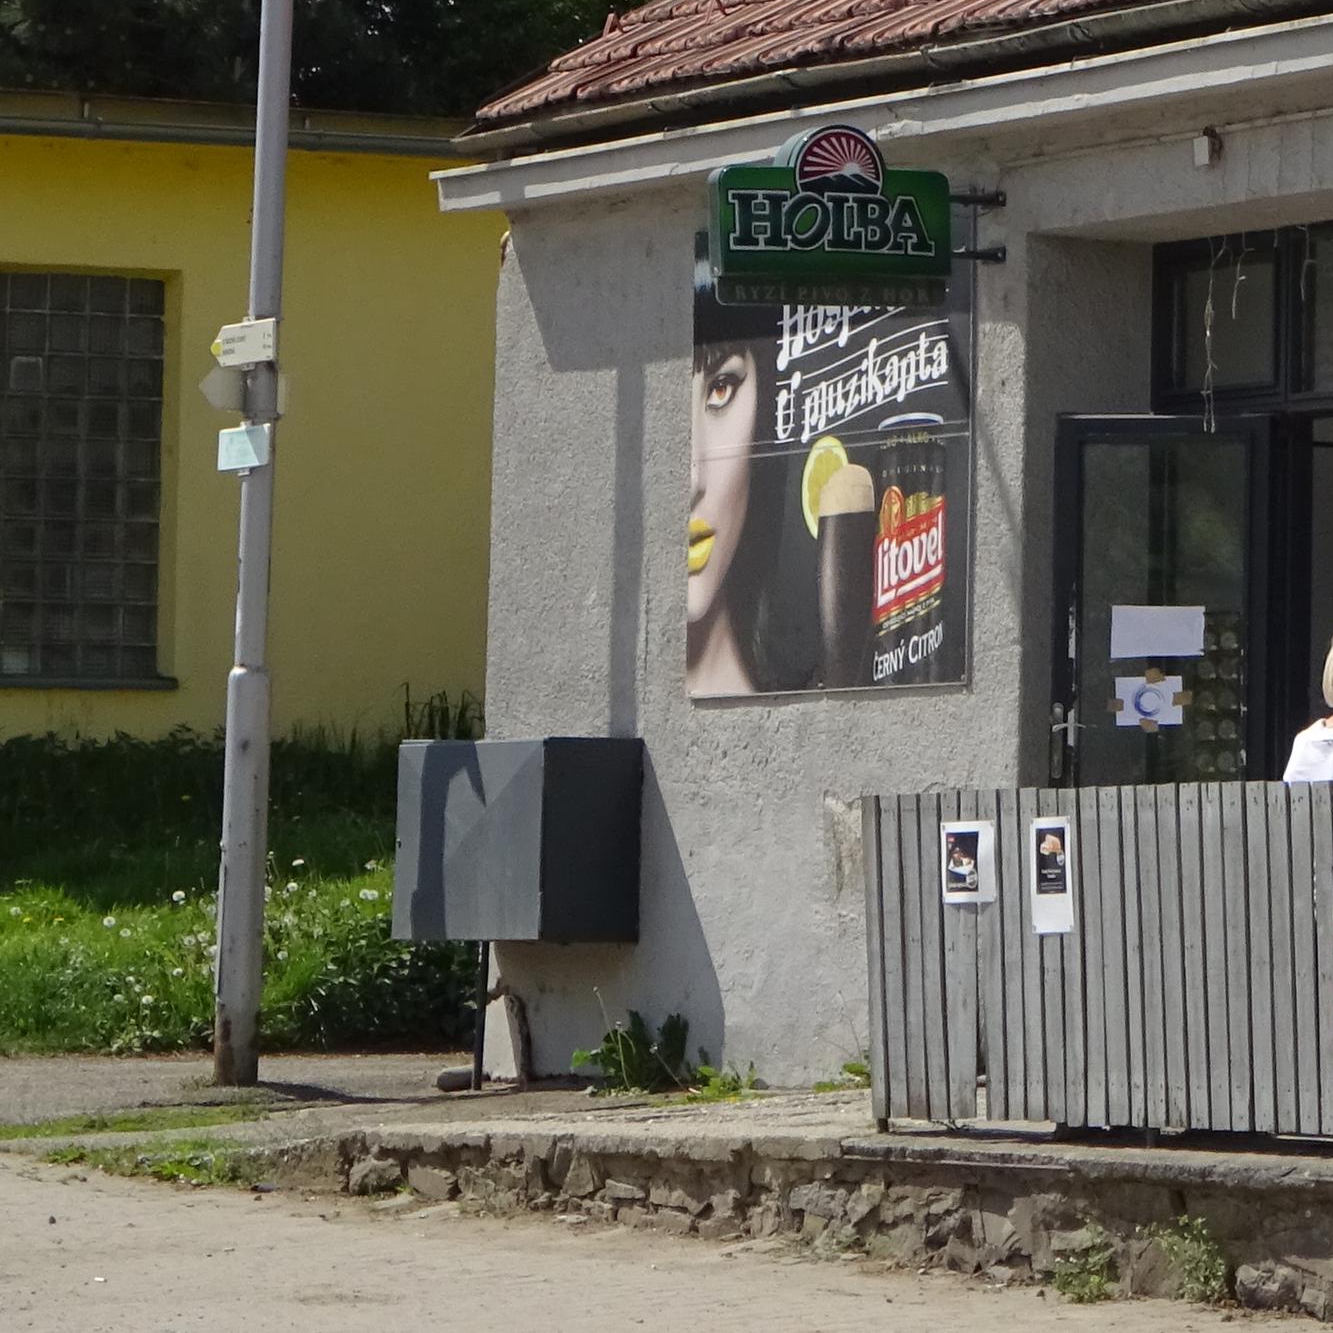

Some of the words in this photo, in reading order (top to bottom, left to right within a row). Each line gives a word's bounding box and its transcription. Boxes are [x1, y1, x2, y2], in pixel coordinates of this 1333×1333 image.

[729, 189, 936, 257] HOLBA
[877, 509, 943, 608] Litovel
[872, 638, 906, 681] ČERNÝ
